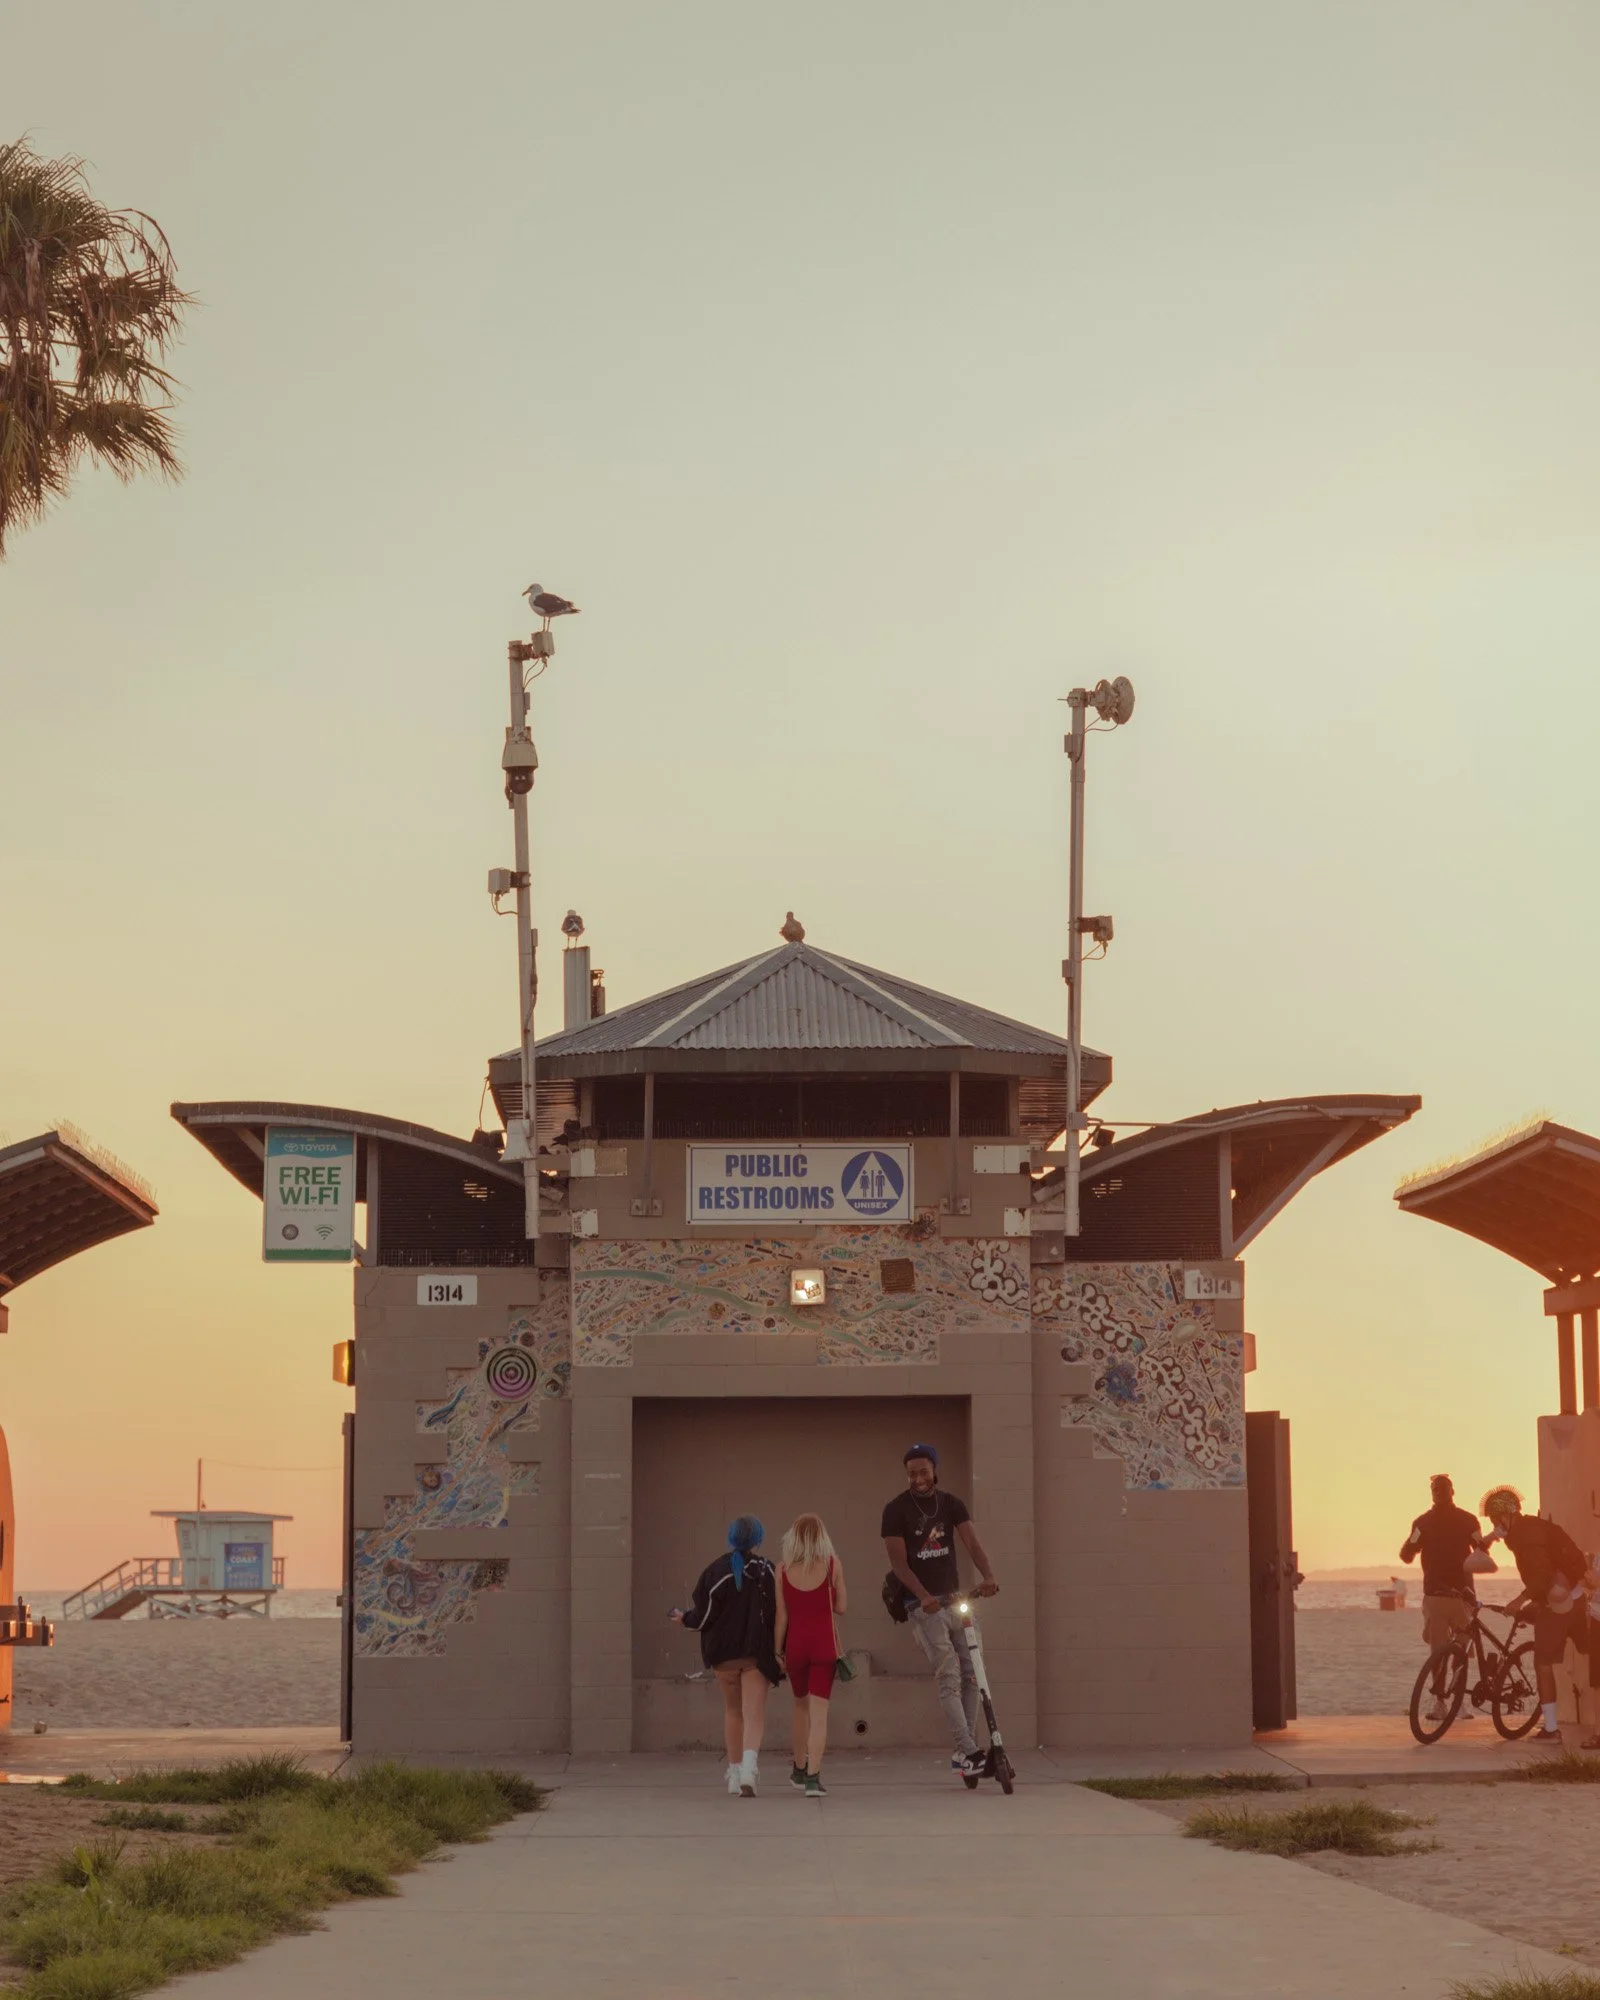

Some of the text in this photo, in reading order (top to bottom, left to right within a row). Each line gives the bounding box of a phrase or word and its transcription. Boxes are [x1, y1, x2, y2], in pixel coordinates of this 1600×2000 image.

[725, 1154, 808, 1177] PUBLIC
[279, 1166, 342, 1185] FREE
[279, 1186, 339, 1205] WI-FI
[698, 1186, 835, 1210] RESTROOMS
[854, 1201, 888, 1209] UNISEX
[428, 1284, 463, 1301] 1314
[1197, 1277, 1232, 1293] 1314
